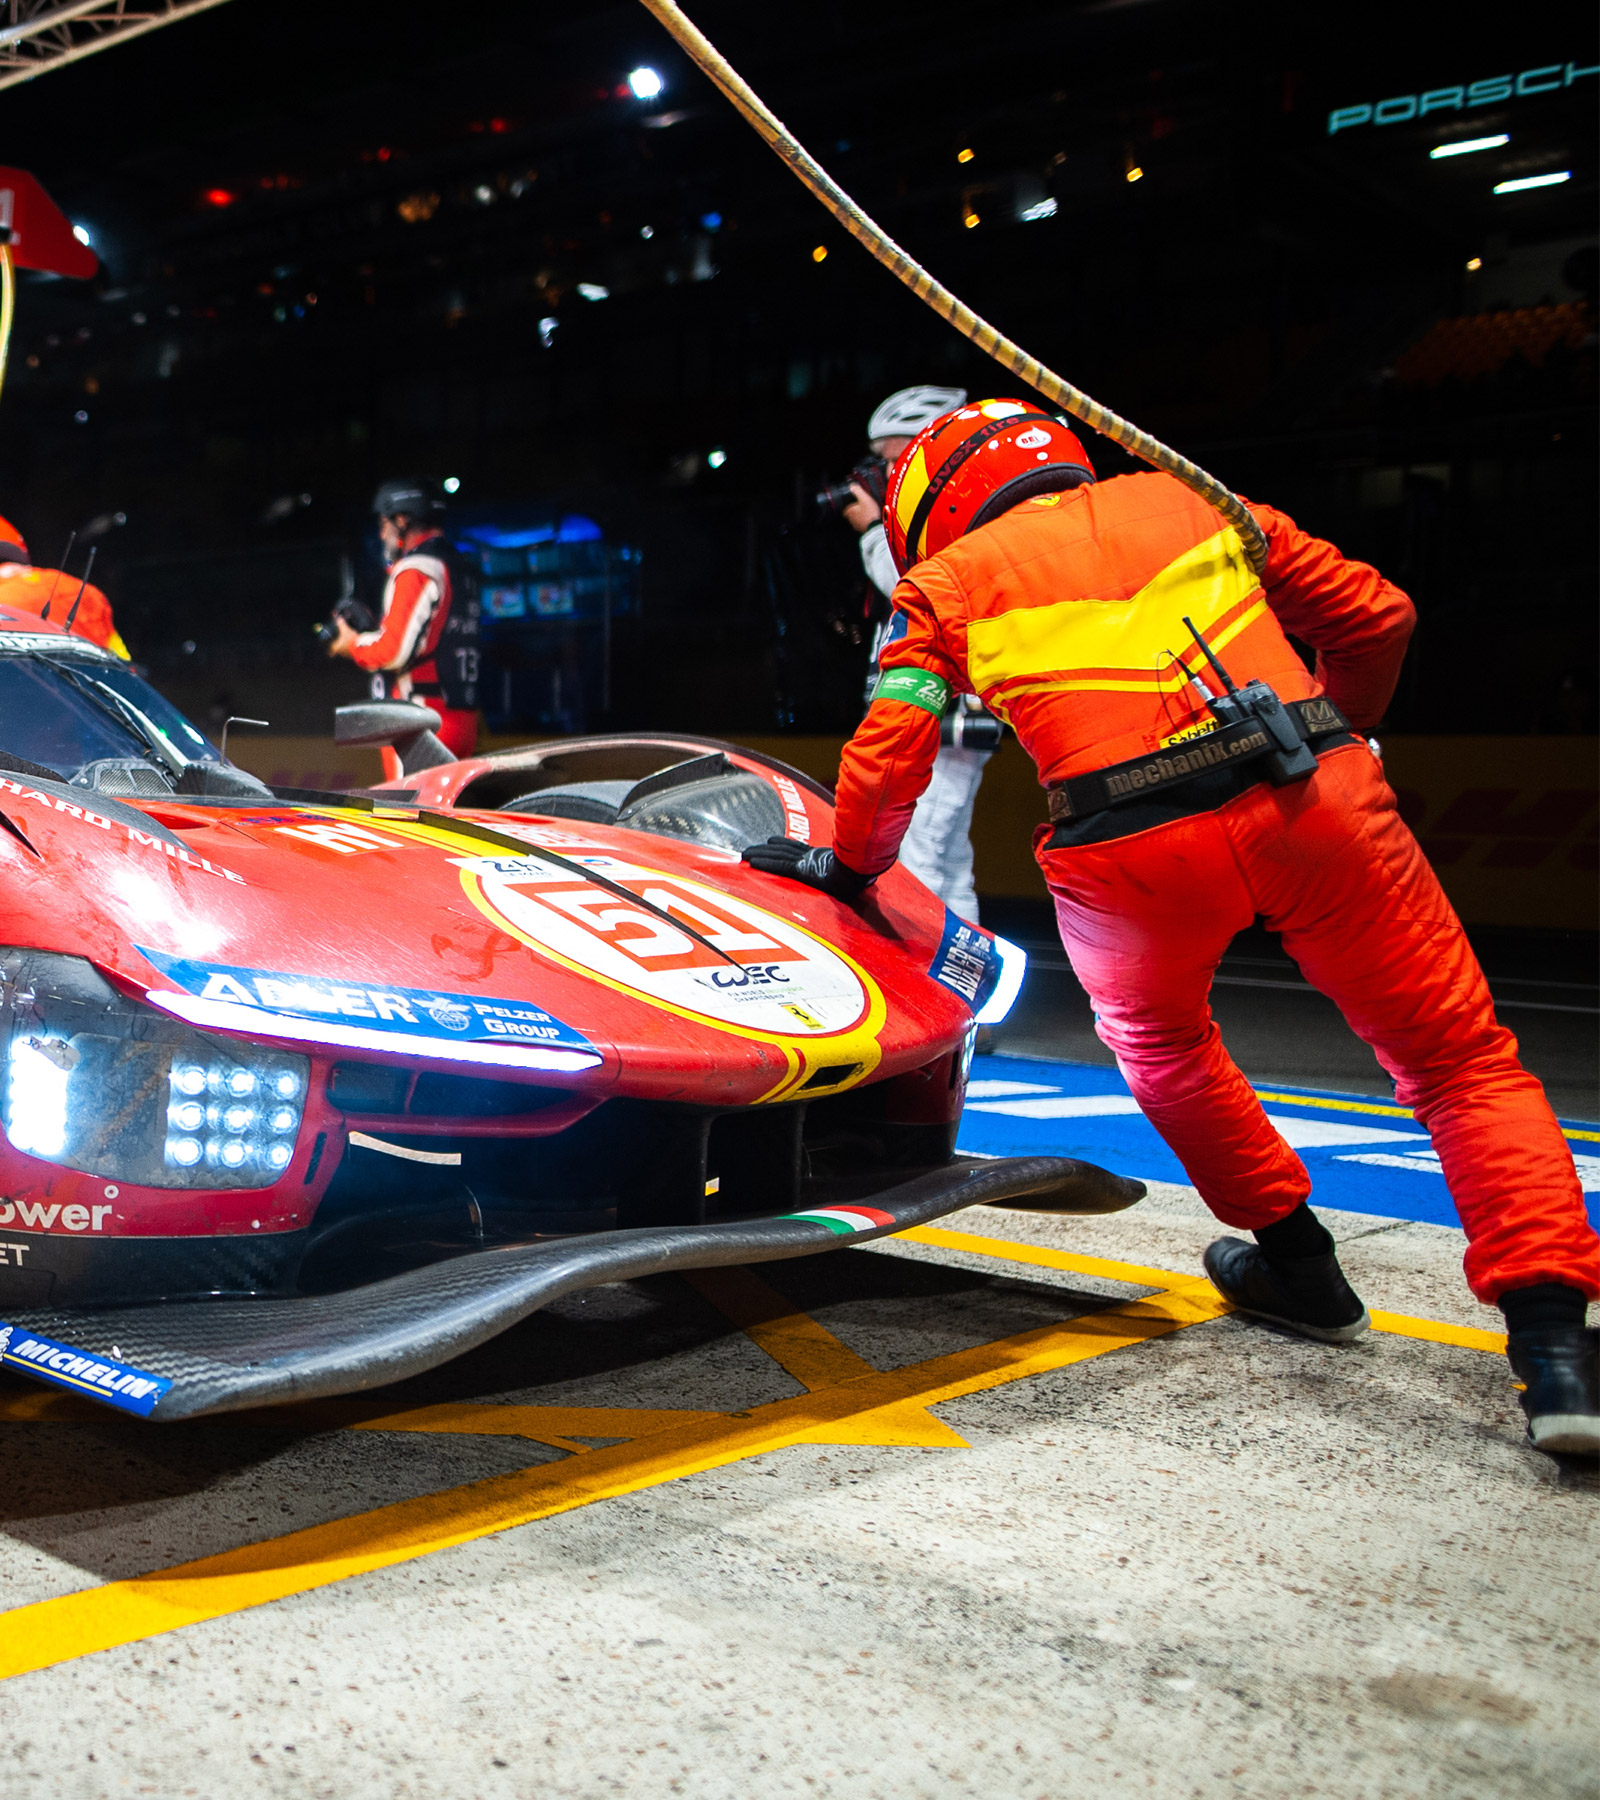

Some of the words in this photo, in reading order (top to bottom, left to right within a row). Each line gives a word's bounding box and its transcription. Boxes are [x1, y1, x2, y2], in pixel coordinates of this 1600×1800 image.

[928, 440, 977, 494] uvex
[980, 416, 1020, 437] fire
[1106, 729, 1269, 797] mechanix.com
[127, 828, 248, 886] MILLE
[533, 888, 783, 958] 51
[200, 971, 420, 1024] ADLER
[711, 965, 791, 989] WEC
[471, 1001, 553, 1023] PELZER
[483, 1018, 560, 1039] GROUP
[12, 1338, 158, 1399] MICHELIN
